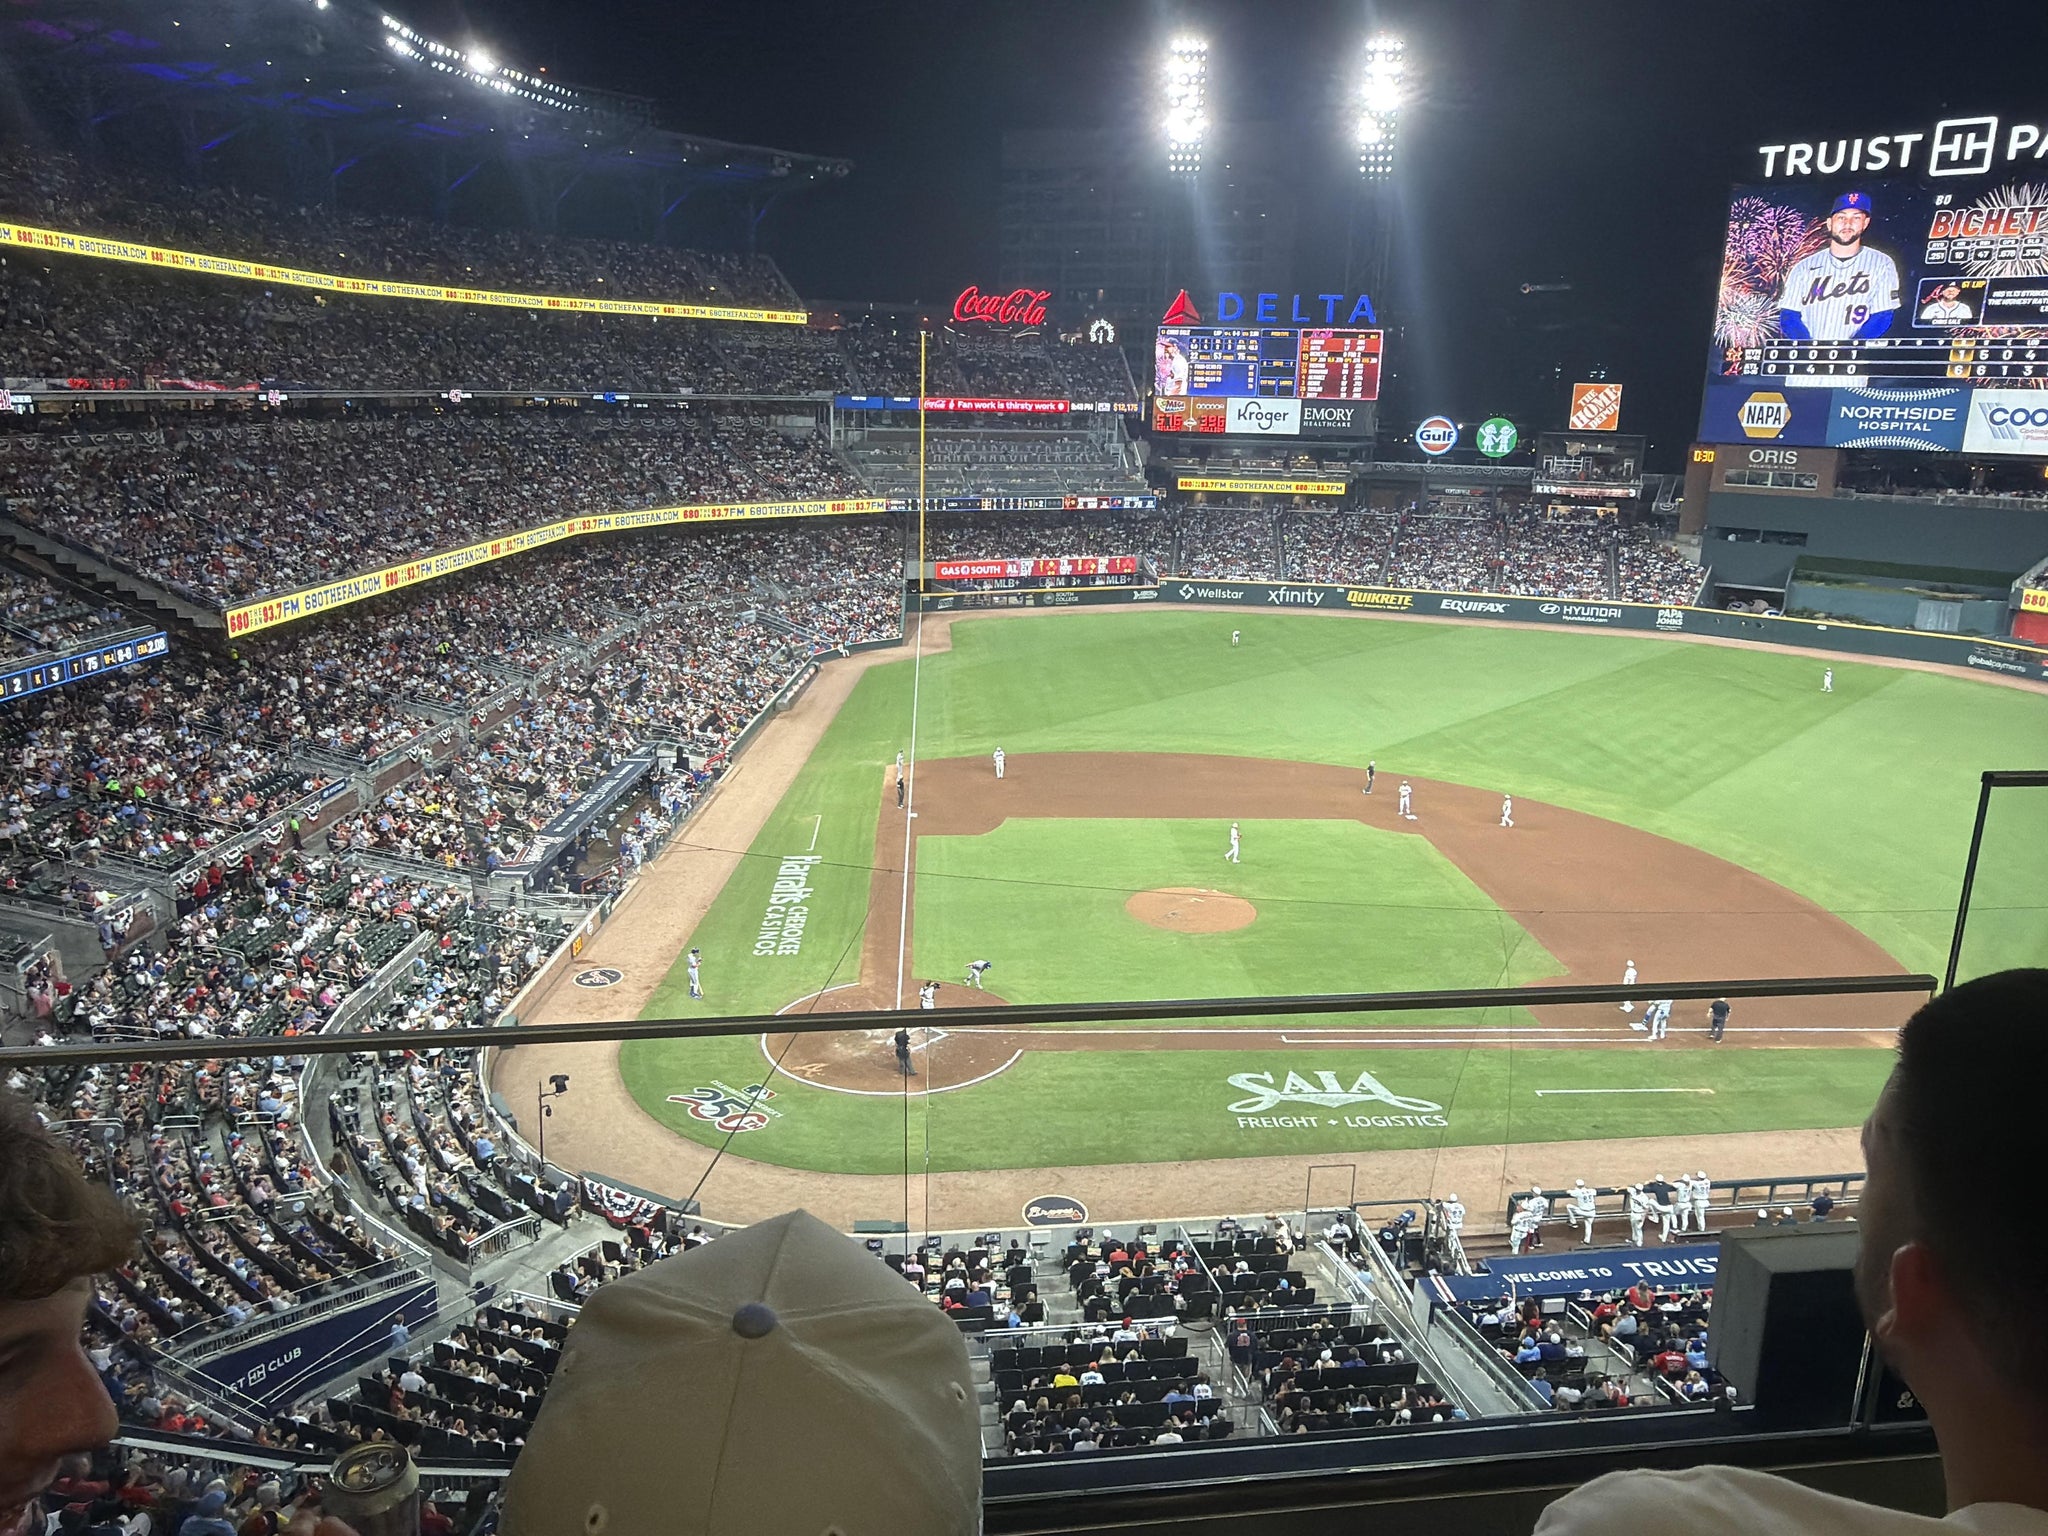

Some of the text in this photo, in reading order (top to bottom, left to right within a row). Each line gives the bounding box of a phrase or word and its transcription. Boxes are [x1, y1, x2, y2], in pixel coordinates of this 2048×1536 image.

[1759, 134, 1923, 177] TRUIST
[1935, 194, 1952, 205] BO
[1954, 251, 1964, 259] 10
[1977, 250, 1990, 258] 47
[79, 239, 147, 260] 680THEFAN.COM
[382, 284, 443, 297] 680THEFAN.COM
[599, 303, 659, 313] 680THEFAN.COM
[709, 309, 764, 320] 680THEFAN.COM
[1802, 271, 1870, 305] Mets
[953, 285, 1051, 325] Coca-Cola
[1218, 292, 1377, 324] DELTA
[1844, 304, 1868, 325] 19
[1769, 350, 1778, 359] 0
[1789, 350, 1798, 359] 0
[1808, 350, 1818, 359] 0
[1828, 350, 1838, 359] 0
[1850, 350, 1857, 359] 1
[1958, 349, 1965, 359] 1
[2002, 349, 2013, 360] 0
[2025, 349, 2036, 360] 4
[1767, 364, 1776, 374] 0
[1788, 364, 1795, 374] 1
[1806, 364, 1815, 374] 4
[1828, 364, 1835, 374] 1
[1846, 364, 1856, 374] 0
[1954, 365, 1963, 375] 6
[1976, 365, 1986, 375] 6
[2001, 365, 2008, 376] 1
[2022, 365, 2033, 376] 3
[1577, 388, 1599, 408] THE
[957, 400, 972, 409] Fan
[974, 400, 996, 409] work
[997, 400, 1005, 409] is
[1006, 401, 1033, 412] thirsty
[1034, 402, 1056, 410] work
[1303, 407, 1355, 420] EMORY
[1570, 384, 1621, 429] HOME
[1840, 406, 1957, 421] NORTHSIDE
[1237, 400, 1290, 430] Kroger
[1588, 400, 1619, 429] DEPOT
[1746, 404, 1782, 426] NAPA
[1303, 420, 1351, 428] HEALTHCARE
[1858, 421, 1931, 432] HOSPITAL
[1419, 429, 1454, 442] Gulf
[1749, 449, 1798, 465] ORIS
[1229, 482, 1292, 491] 680THEFAN.COM
[229, 610, 250, 633] 680
[304, 575, 381, 610] 680THEFAN.COM
[435, 546, 488, 572] 680THEFAN.COM
[615, 510, 679, 527] 680THEFAN.COM
[683, 509, 700, 519] 680
[750, 503, 826, 516] 680THEFAN.COM
[831, 503, 846, 512] 680
[941, 565, 1001, 575] GAS SOUTH
[1006, 565, 1018, 574] AL
[1106, 574, 1132, 585] MLB+
[1197, 588, 1244, 599] Wellstar
[1267, 586, 1325, 607] xfinity
[1346, 590, 1413, 606] QUIKRETE
[2023, 593, 2046, 607] 680
[1440, 598, 1508, 613] EQUIFAX
[1563, 605, 1622, 618] HYUNDAI
[1656, 617, 1683, 626] JOHNS
[1658, 609, 1683, 619] PAPA
[13, 677, 22, 693] 2
[51, 666, 59, 682] 3
[73, 662, 79, 674] T
[85, 657, 99, 672] 75
[752, 905, 786, 956] CASINOS
[776, 906, 809, 956] CHEROKEE
[1227, 1070, 1443, 1113] SAIA
[1237, 1115, 1449, 1128] FREIGHT LOGISTICS
[1502, 1269, 1588, 1284] WELCOME
[1589, 1267, 1613, 1279] TO
[268, 1347, 302, 1373] CLUB
